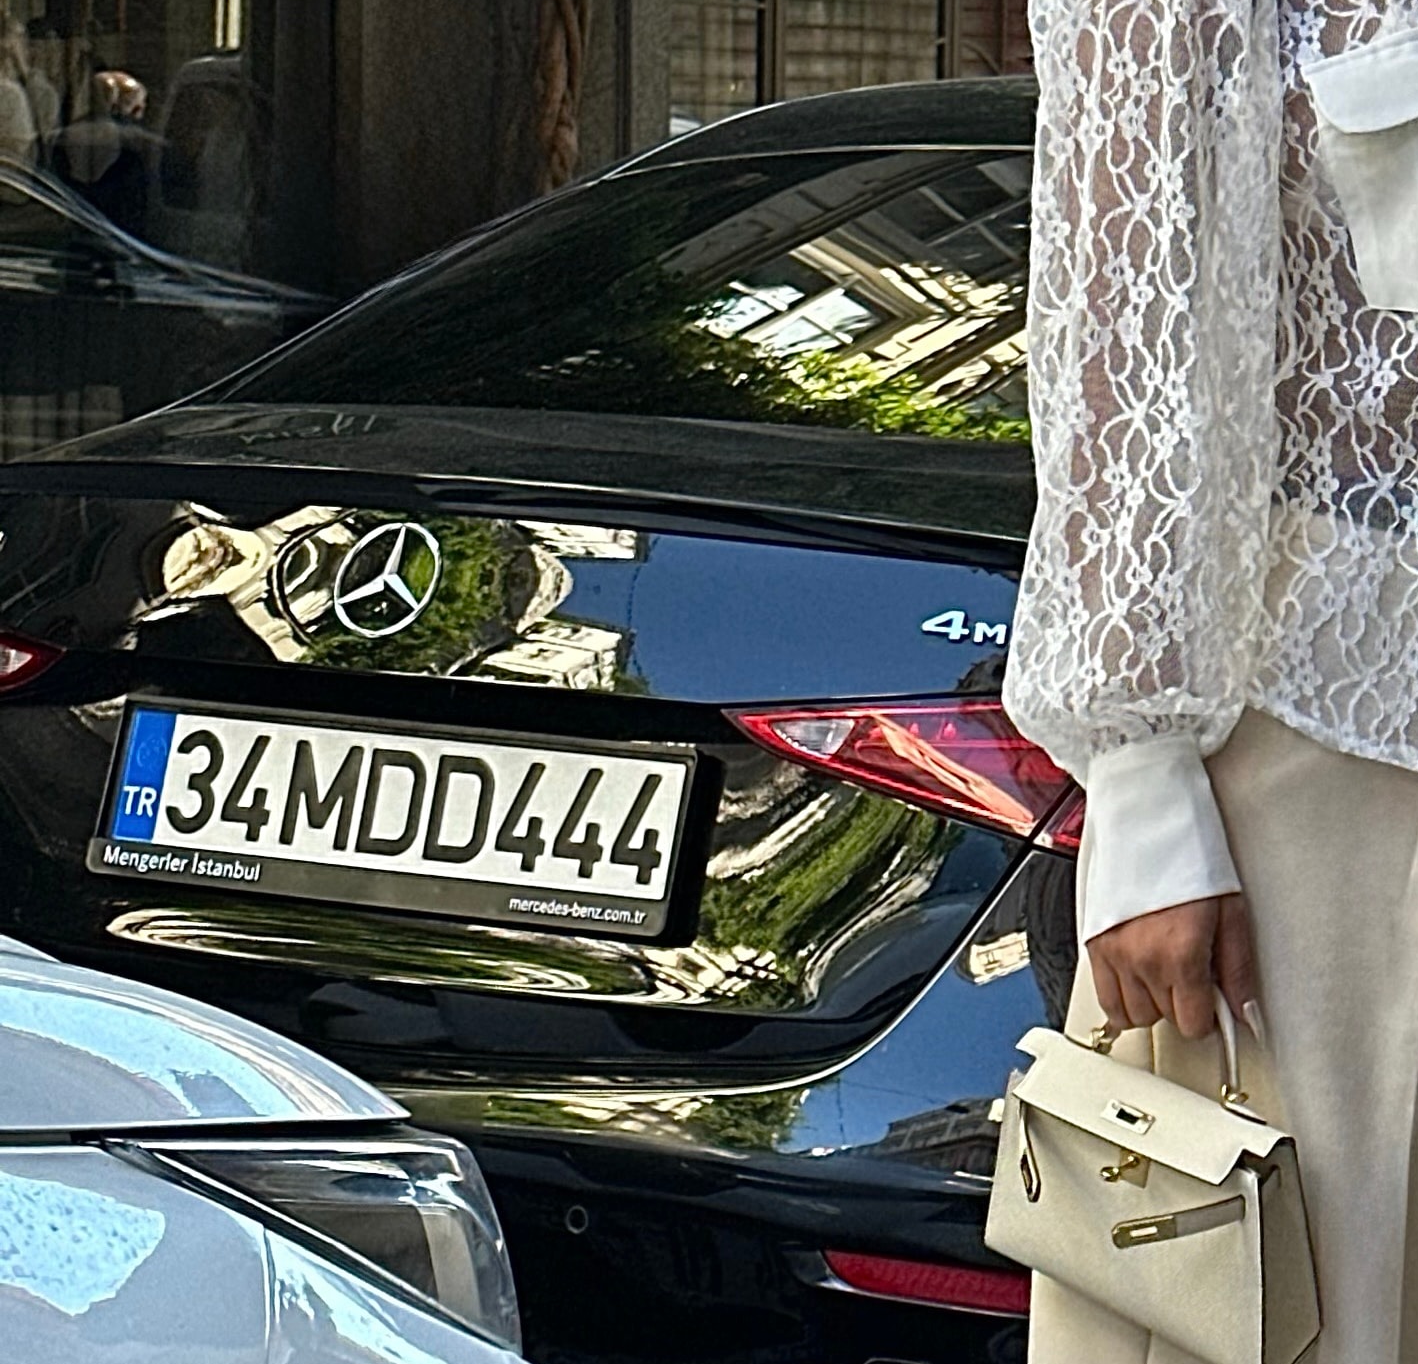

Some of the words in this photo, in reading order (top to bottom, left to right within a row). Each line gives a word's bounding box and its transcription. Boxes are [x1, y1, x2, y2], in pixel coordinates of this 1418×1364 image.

[122, 785, 157, 818] TR
[165, 729, 663, 886] 34MDD444
[103, 844, 188, 874] Mengerler
[509, 896, 647, 925] mercedes-benz.com.tr
